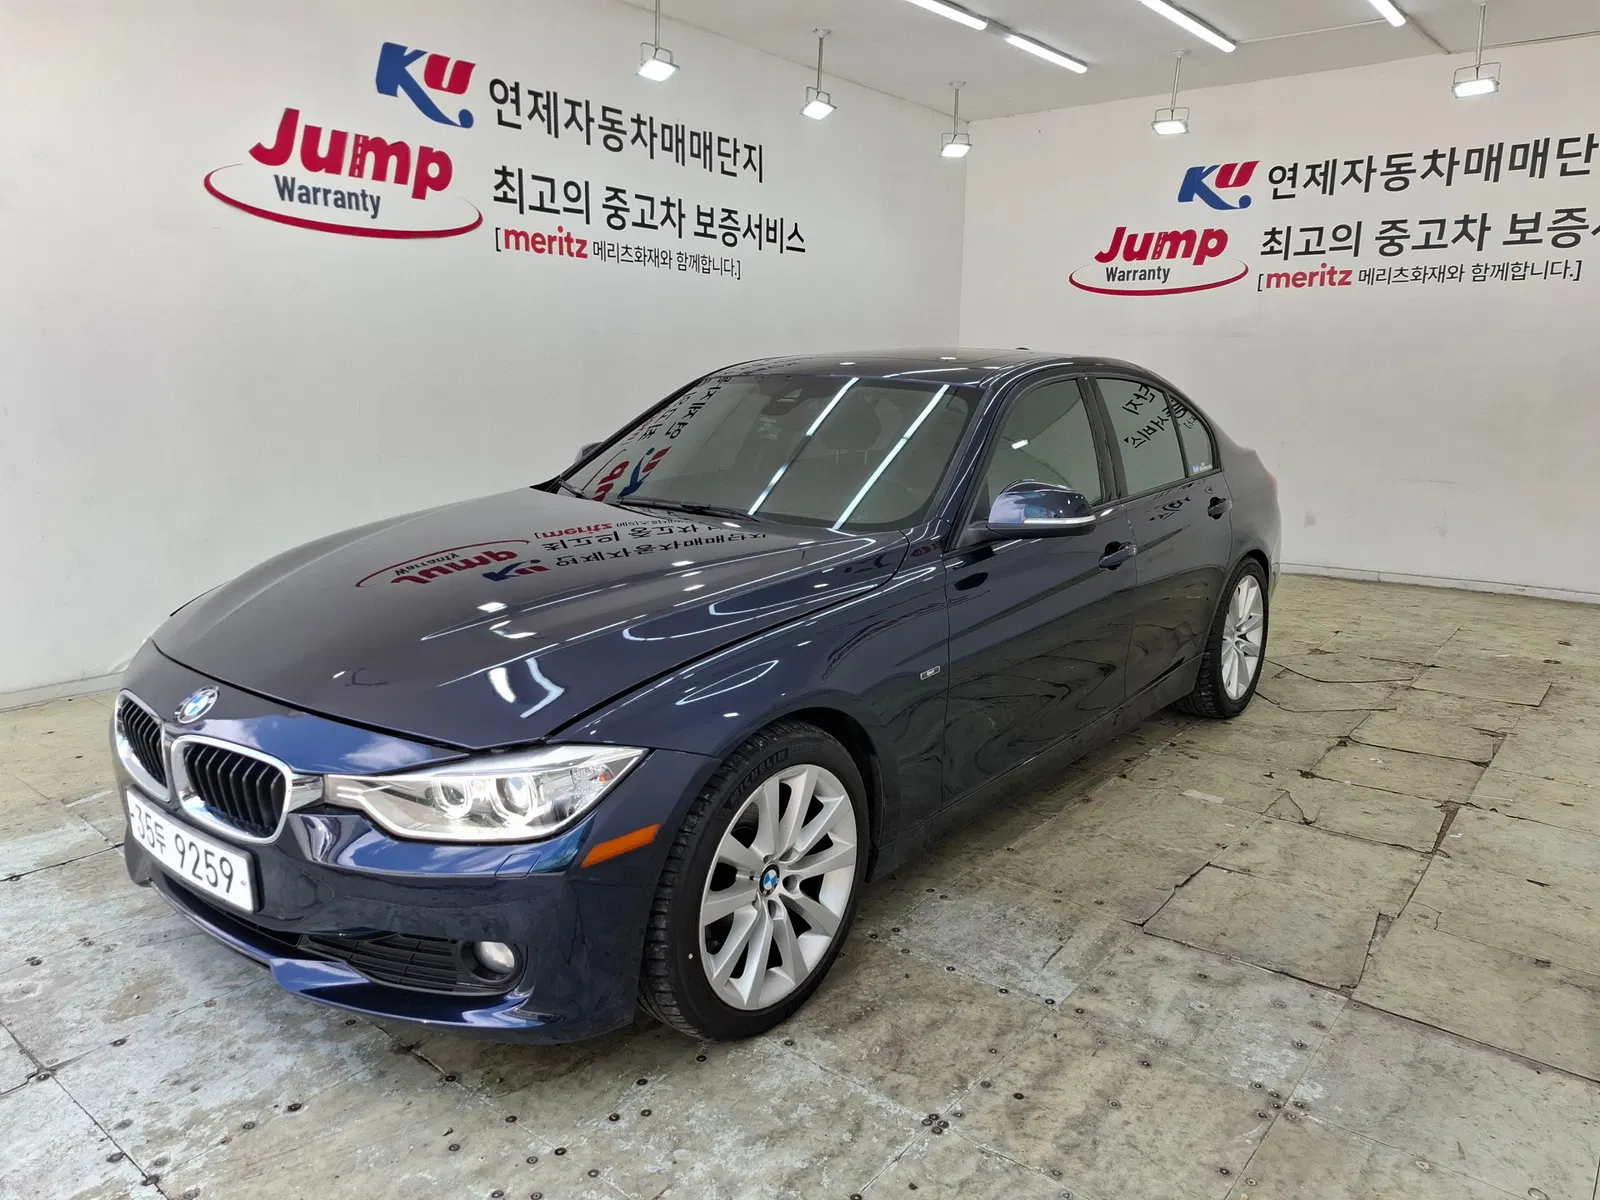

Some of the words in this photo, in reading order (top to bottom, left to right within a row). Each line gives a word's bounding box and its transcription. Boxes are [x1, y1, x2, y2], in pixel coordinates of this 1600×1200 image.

[248, 107, 453, 200] Jump
[489, 77, 764, 184] 연제자동차매매단지
[274, 174, 381, 219] Warranty
[493, 165, 591, 223] 최고의
[601, 184, 686, 239] 중고차
[693, 203, 806, 255] 보증서비스
[593, 239, 673, 271] 메리츠화재와
[1094, 226, 1228, 266] Jump
[1260, 220, 1363, 261] 최고의
[1374, 212, 1492, 257] 중고차
[1502, 207, 1600, 249] 보증
[1104, 265, 1171, 284] Warranty
[1358, 263, 1465, 286] 메리츠화재와
[135, 804, 166, 854] 35두
[174, 833, 234, 894] 9259
